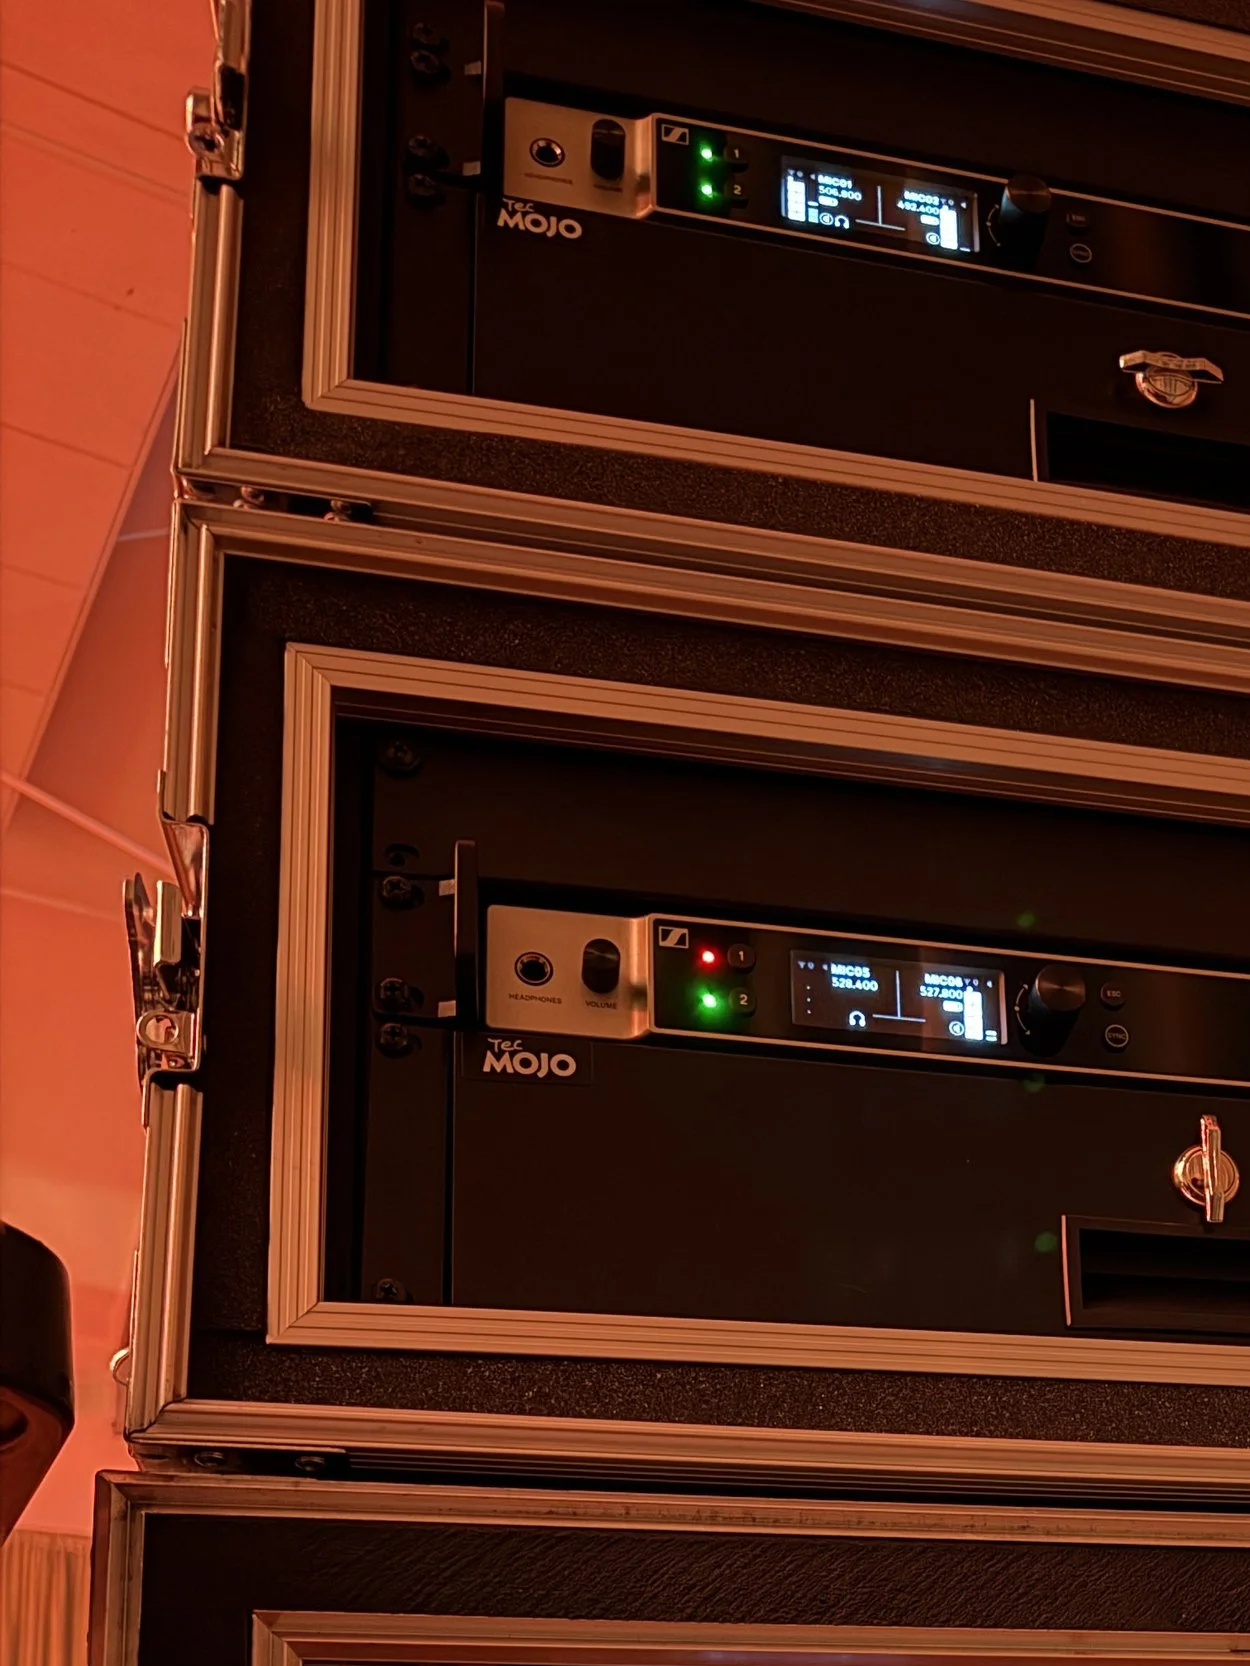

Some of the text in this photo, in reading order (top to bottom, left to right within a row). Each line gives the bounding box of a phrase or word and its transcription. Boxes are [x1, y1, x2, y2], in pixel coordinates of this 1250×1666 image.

[733, 147, 740, 159] 1
[733, 184, 742, 196] 2
[496, 207, 583, 240] MOJO
[738, 950, 744, 961] 1
[830, 963, 871, 979] MIC05
[508, 993, 562, 1004] HEADPHONES
[740, 994, 748, 1005] 2
[487, 1037, 523, 1053] Tec
[482, 1050, 577, 1078] MOJO
